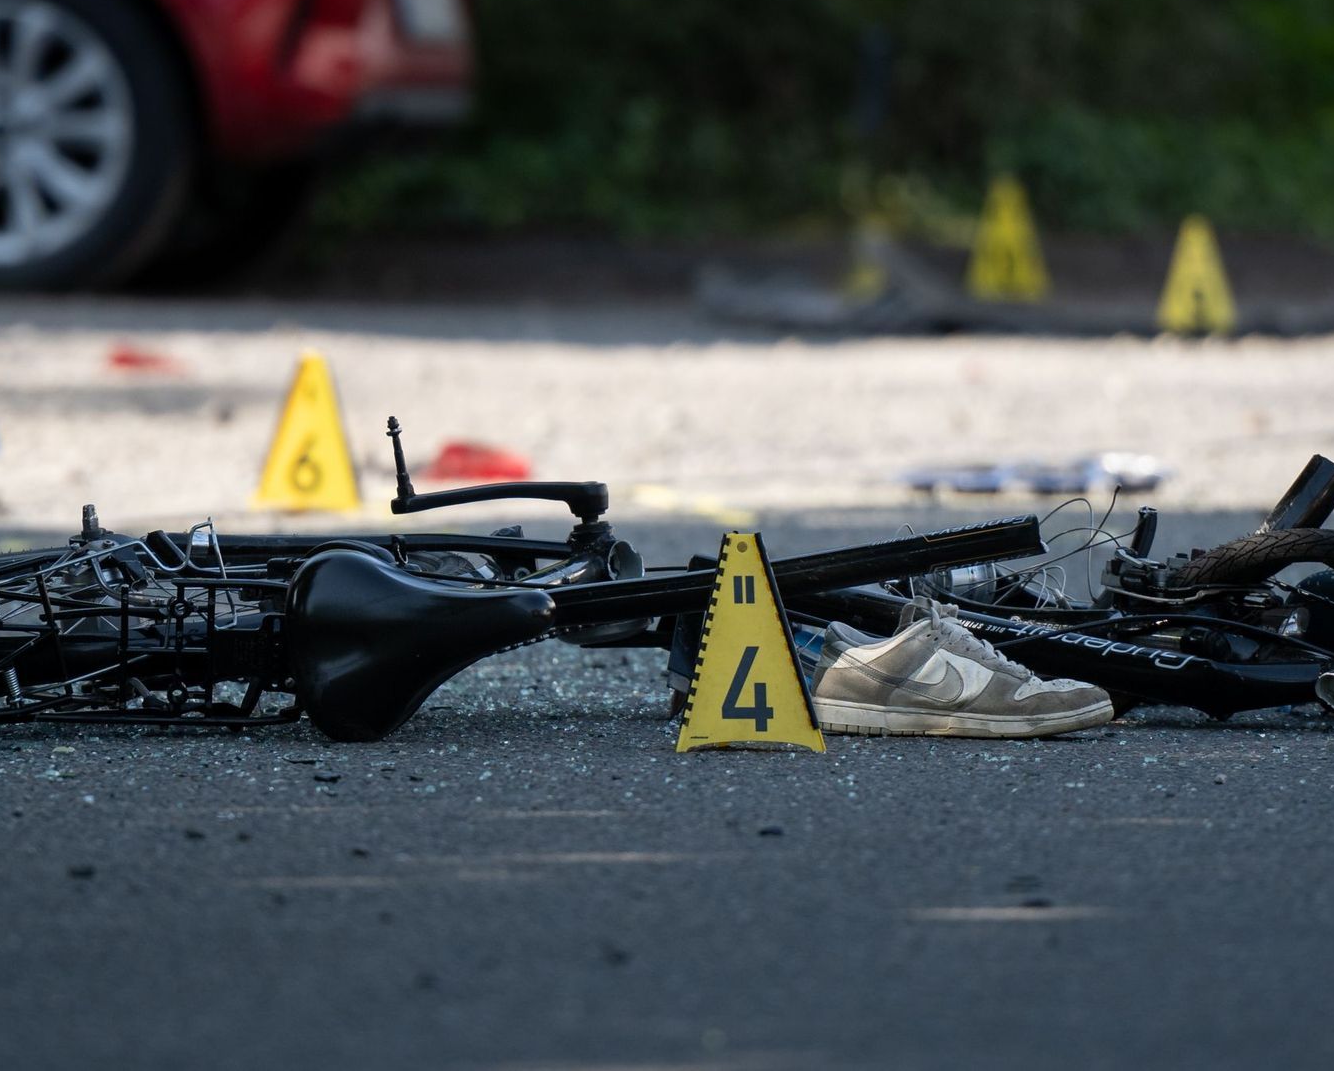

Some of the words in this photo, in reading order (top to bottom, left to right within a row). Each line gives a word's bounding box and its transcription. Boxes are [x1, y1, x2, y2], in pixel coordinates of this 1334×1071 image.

[290, 431, 323, 494] 6
[986, 624, 1007, 634] BIKE
[721, 646, 774, 732] 4
